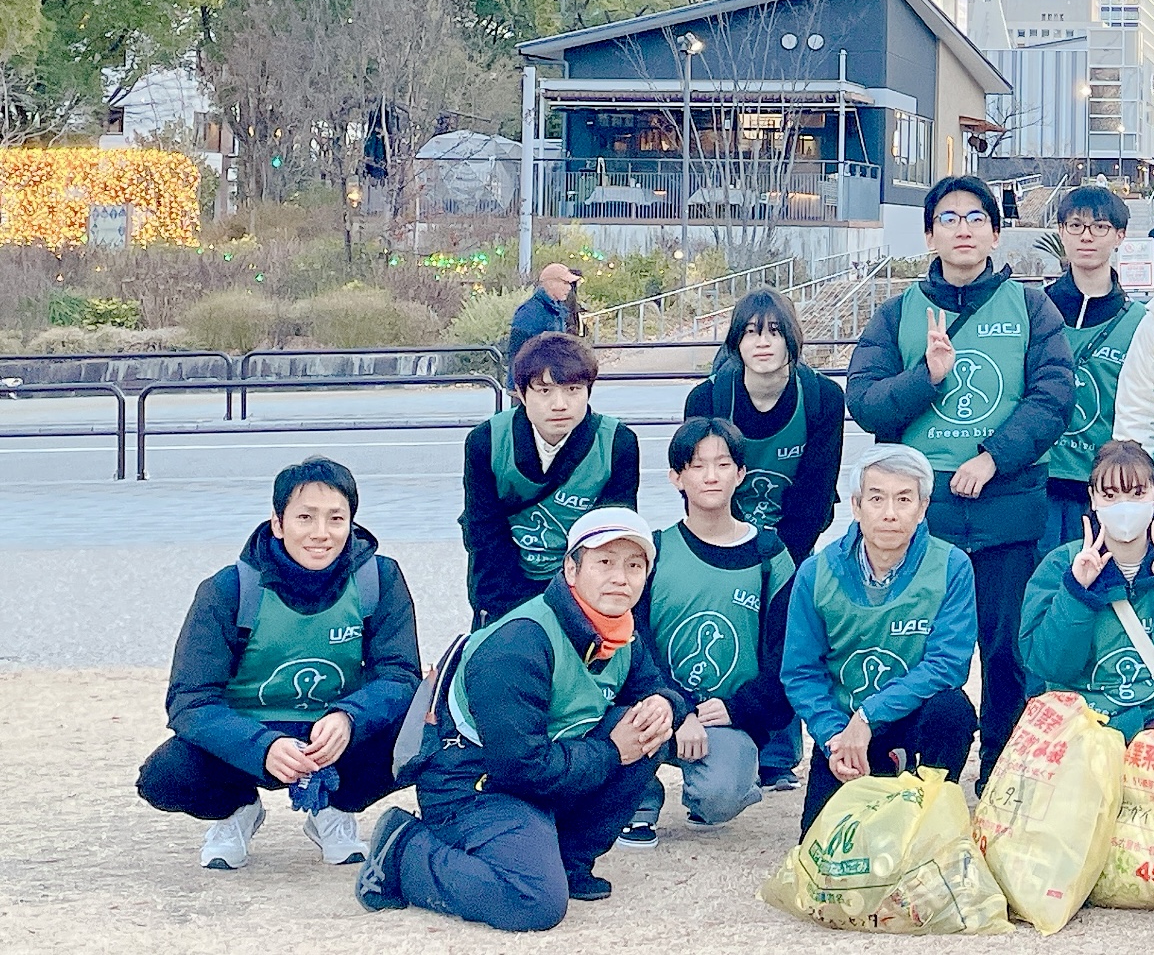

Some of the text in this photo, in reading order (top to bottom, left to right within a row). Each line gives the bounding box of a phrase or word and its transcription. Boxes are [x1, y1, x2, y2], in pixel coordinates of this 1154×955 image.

[977, 323, 1021, 336] UACJ
[927, 427, 995, 439] green bir
